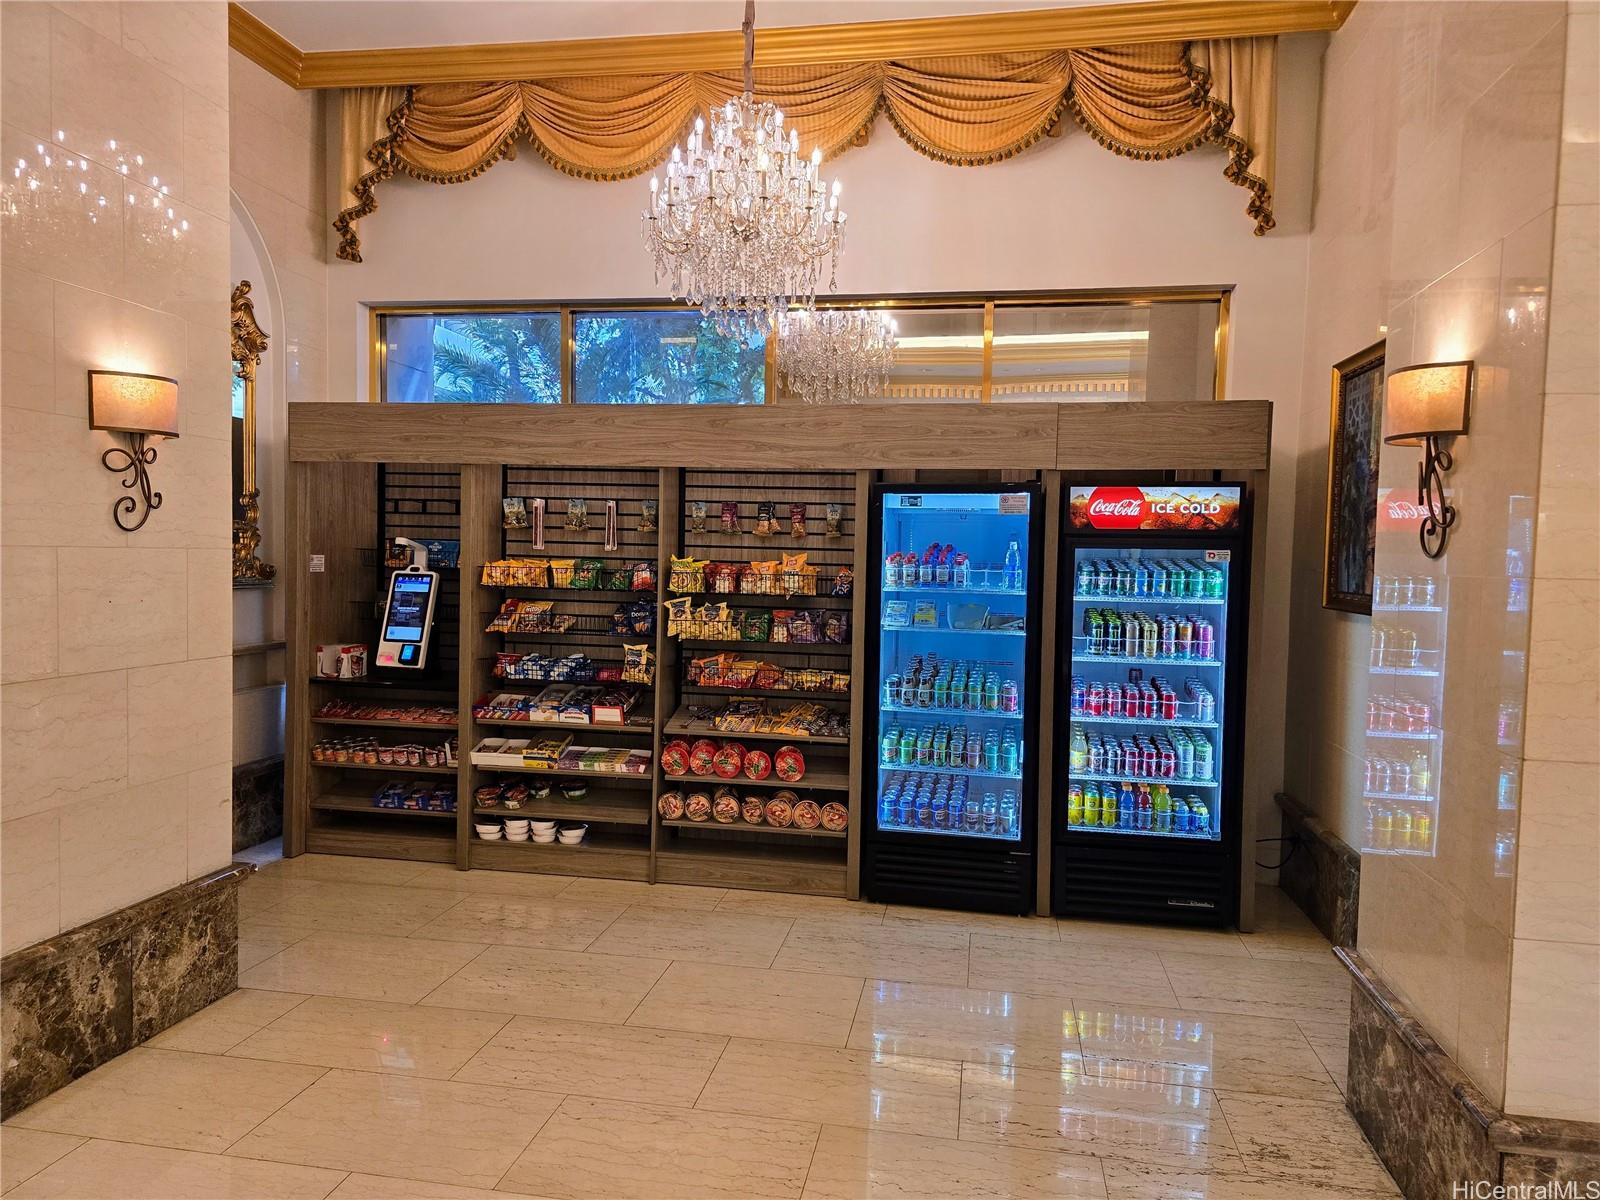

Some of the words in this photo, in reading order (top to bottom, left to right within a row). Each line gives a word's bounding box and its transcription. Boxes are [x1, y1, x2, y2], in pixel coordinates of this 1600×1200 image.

[1090, 499, 1143, 516] Coca-Cola
[1151, 503, 1175, 514] ICE
[1180, 503, 1221, 514] COLD
